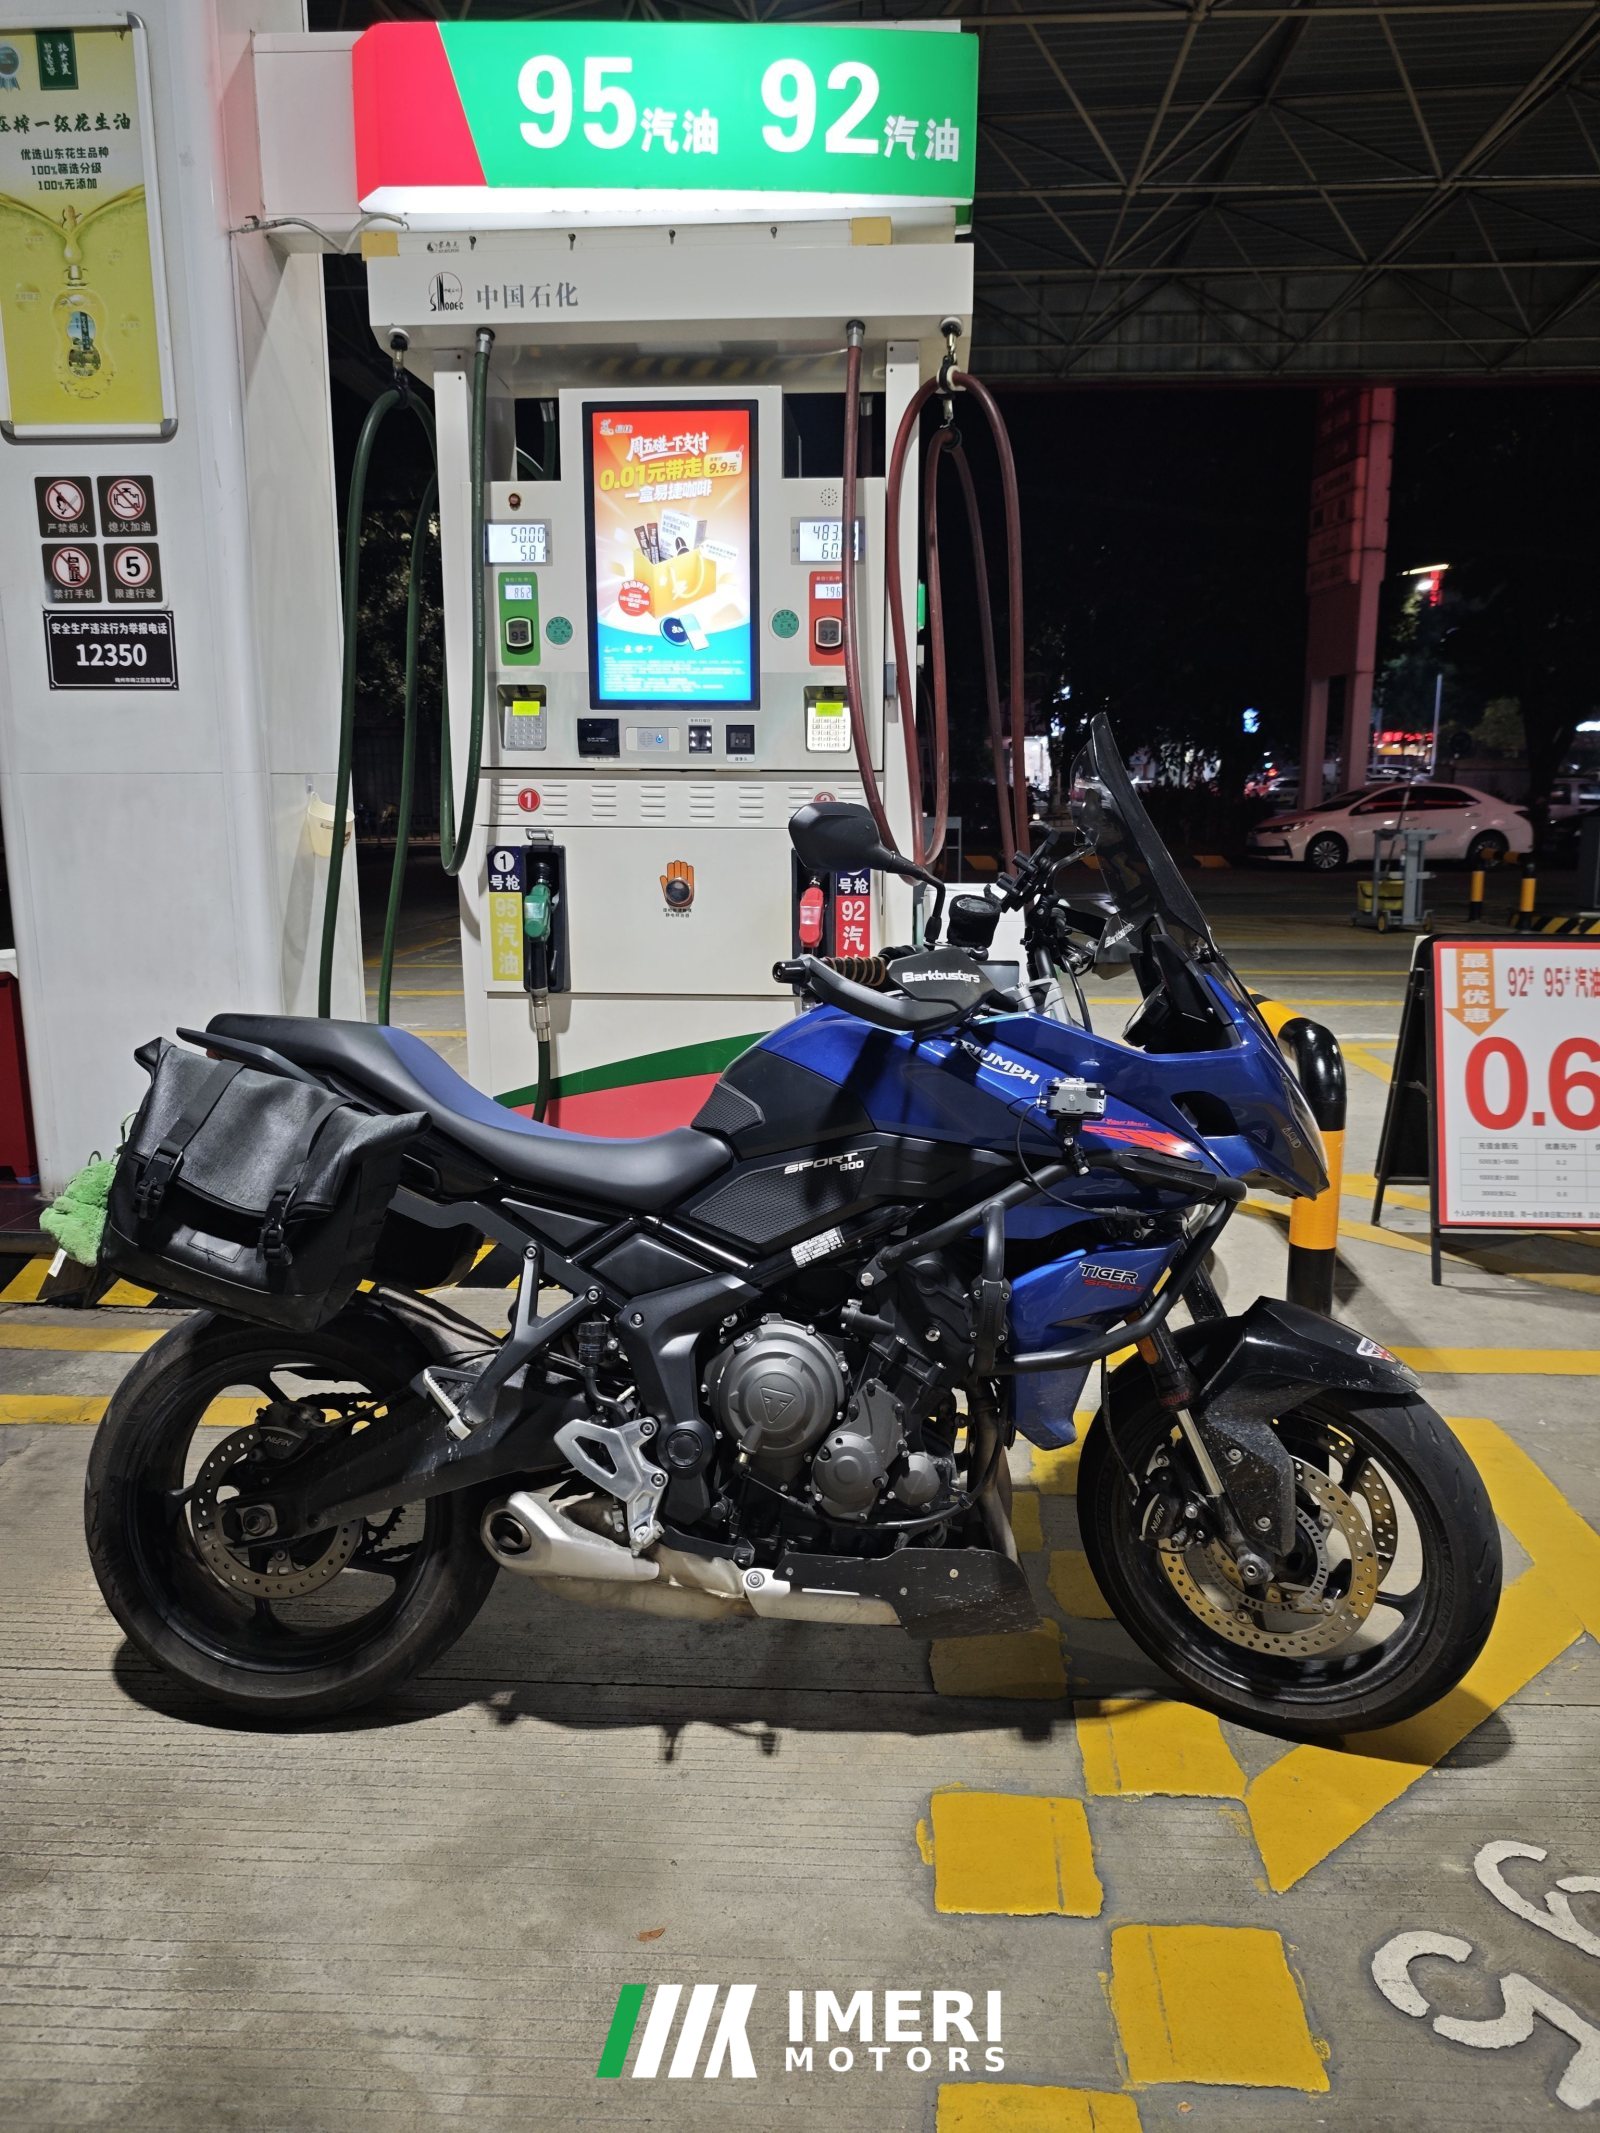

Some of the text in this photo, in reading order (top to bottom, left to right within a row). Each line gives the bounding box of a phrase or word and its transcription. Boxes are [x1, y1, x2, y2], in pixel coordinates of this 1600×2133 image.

[21, 146, 109, 161] 优选山东花生品种
[31, 162, 102, 176] 100%筛选分级
[38, 178, 97, 191] 100%无添加
[476, 282, 579, 310] 中国石化
[626, 432, 709, 462] 周五碰一下支付
[600, 457, 703, 491] 0.01元带走
[709, 461, 737, 474] 9.9元
[624, 479, 713, 503] 一盒易捷咖啡
[47, 523, 90, 534] 严禁烟火
[108, 521, 151, 533] 熄火加油
[125, 555, 141, 577] 5
[53, 588, 95, 600] 禁打手机
[114, 587, 156, 600] 限速行驶
[51, 622, 168, 635] 安全生产违法行为举报电话
[511, 630, 528, 641] 95
[76, 643, 147, 666] 12350
[523, 792, 534, 809] 1
[498, 854, 507, 870] 1
[490, 875, 521, 891] 号枪
[838, 877, 869, 893] 号枪
[902, 969, 980, 984] Barkbusters
[1461, 953, 1490, 1023] 最高优惠
[950, 1036, 1040, 1085] TRIUMPH
[784, 1152, 858, 1174] SPORT
[1081, 1263, 1138, 1284] TIGER
[1083, 1279, 1145, 1293] SPORT
